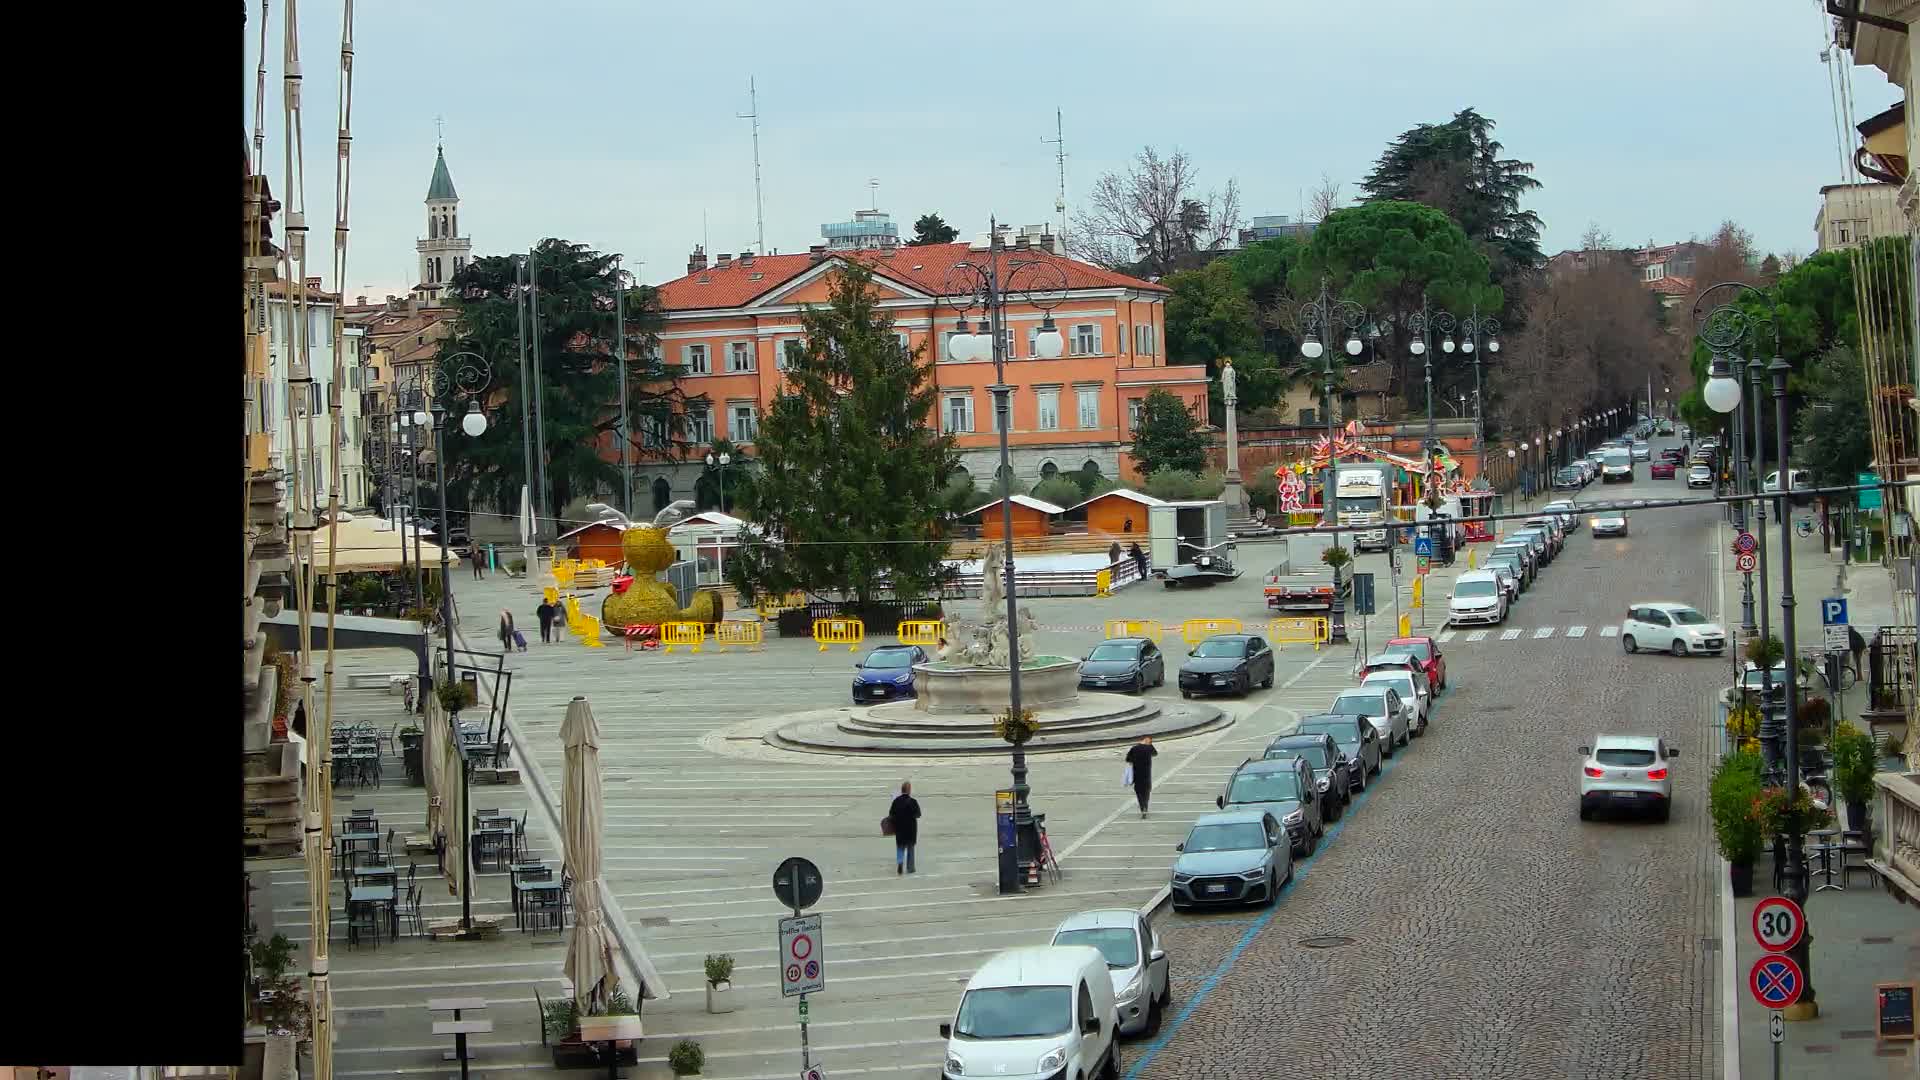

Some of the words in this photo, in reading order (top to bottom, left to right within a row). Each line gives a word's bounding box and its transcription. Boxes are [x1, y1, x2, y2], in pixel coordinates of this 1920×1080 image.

[1743, 557, 1752, 567] 20
[1827, 602, 1842, 622] P
[1763, 912, 1791, 937] 30
